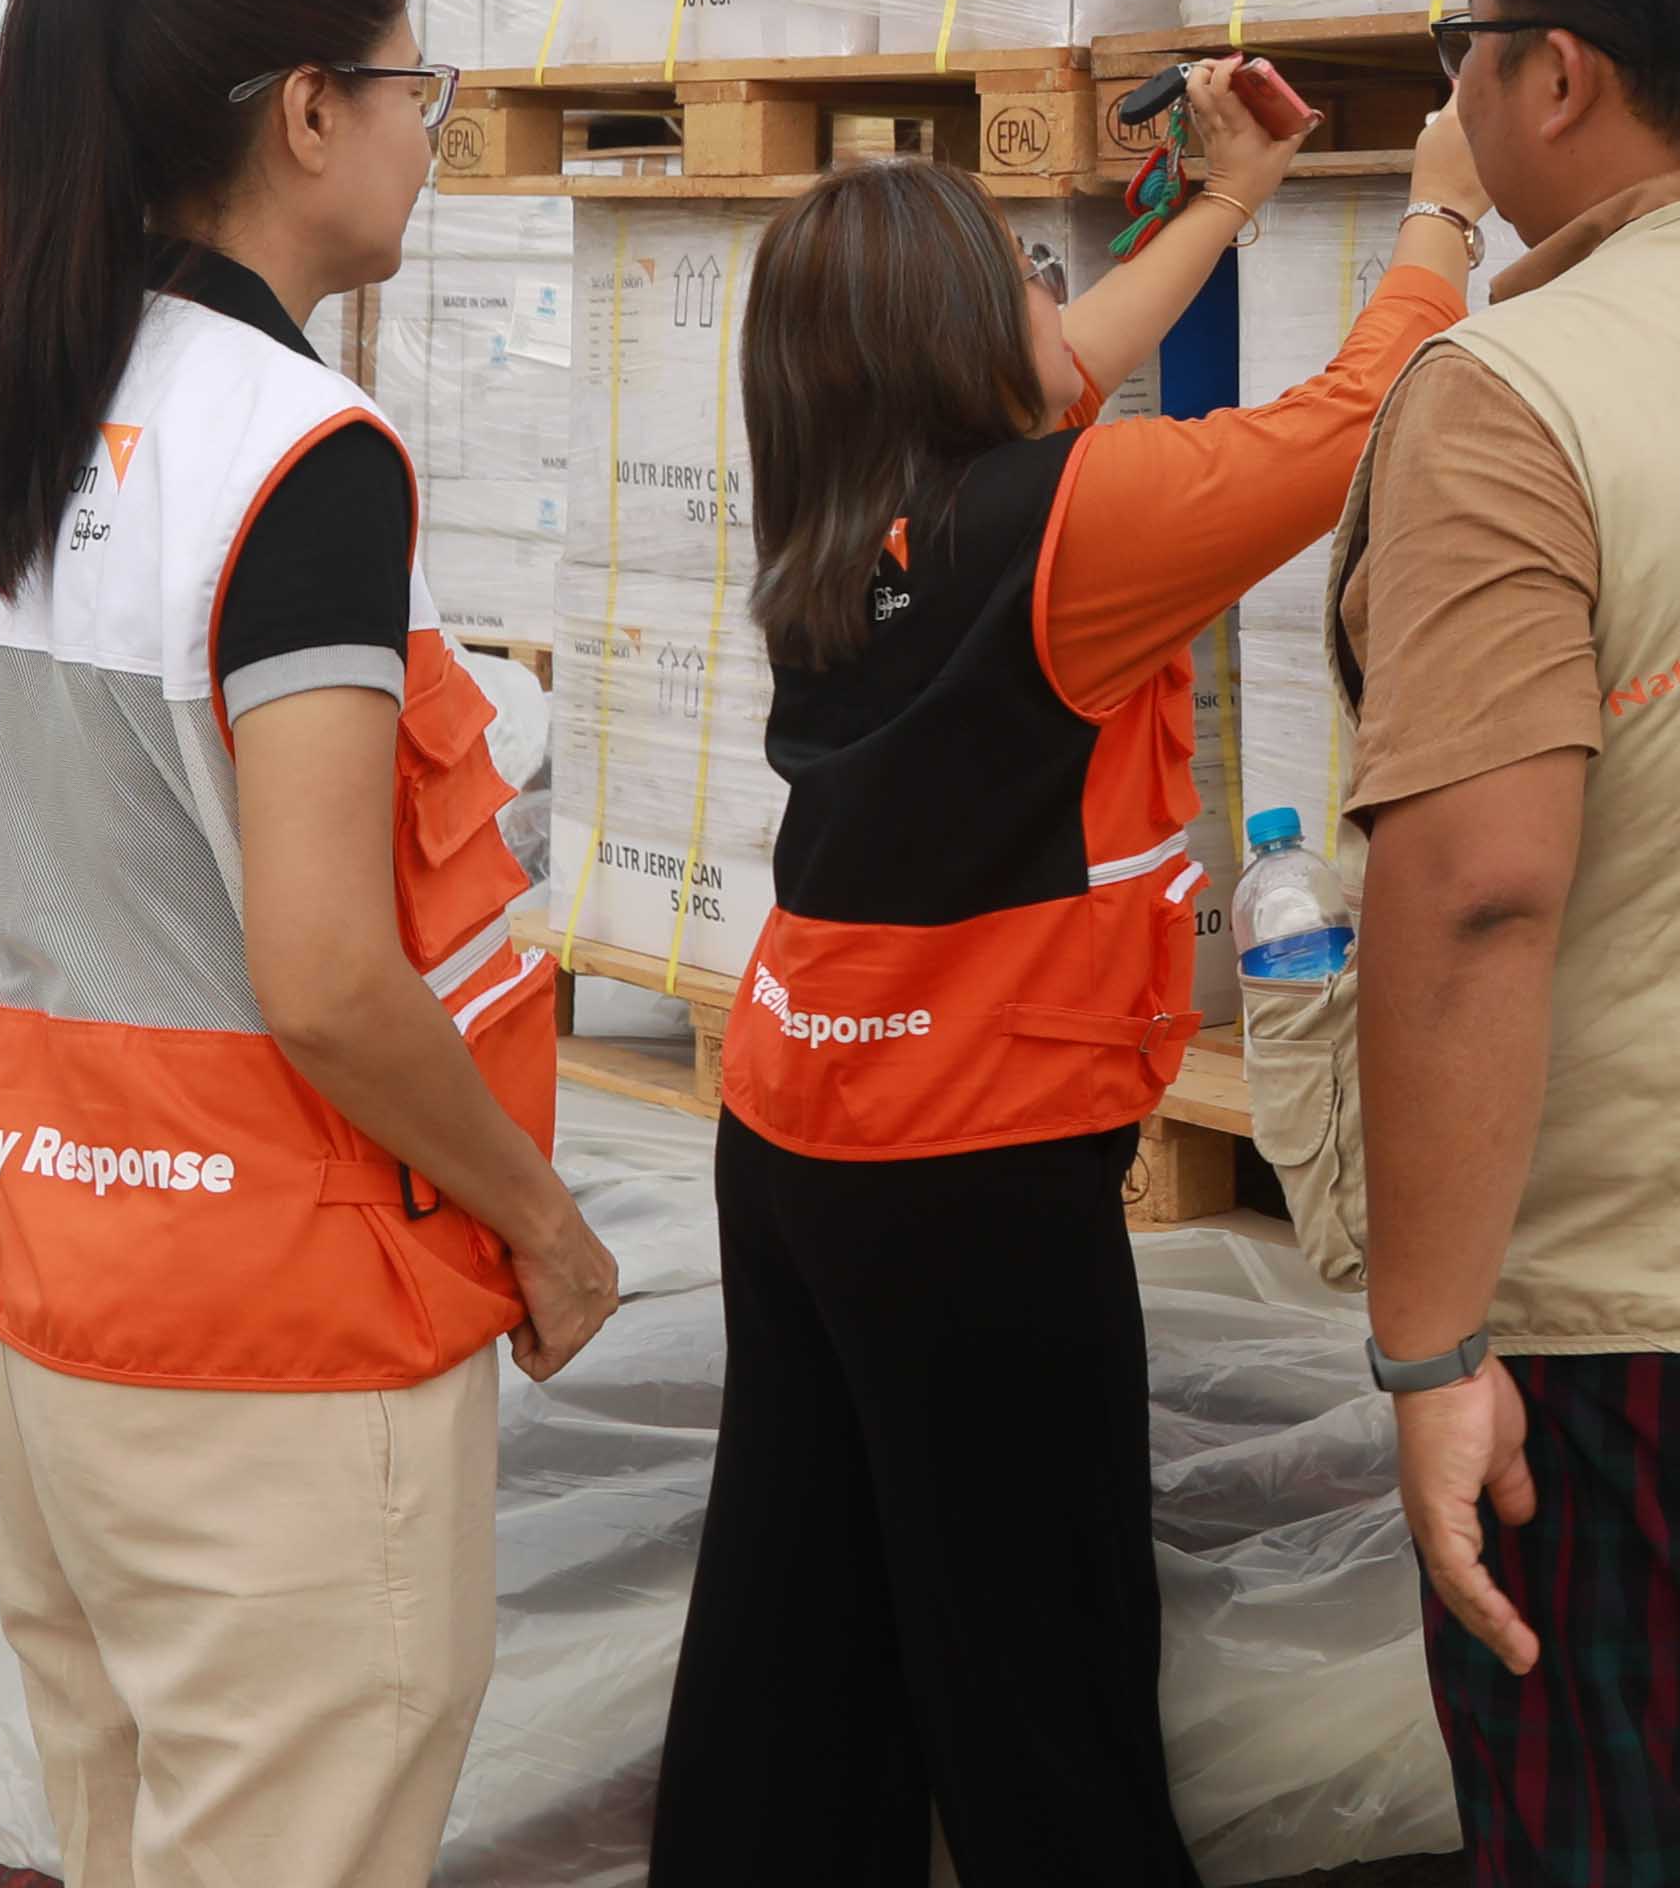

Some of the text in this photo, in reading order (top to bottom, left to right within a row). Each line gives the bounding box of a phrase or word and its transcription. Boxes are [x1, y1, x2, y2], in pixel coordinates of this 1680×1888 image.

[447, 129, 479, 158] EPAL
[997, 118, 1041, 152] EPAL
[443, 296, 508, 309] MADE IN CHINA
[616, 460, 702, 489] 10 LTR JERRY
[466, 615, 503, 628] IN CHINA
[598, 841, 721, 889] 10 LTR JERRY CAN
[693, 896, 725, 922] PCS.
[23, 1124, 235, 1195] Response
